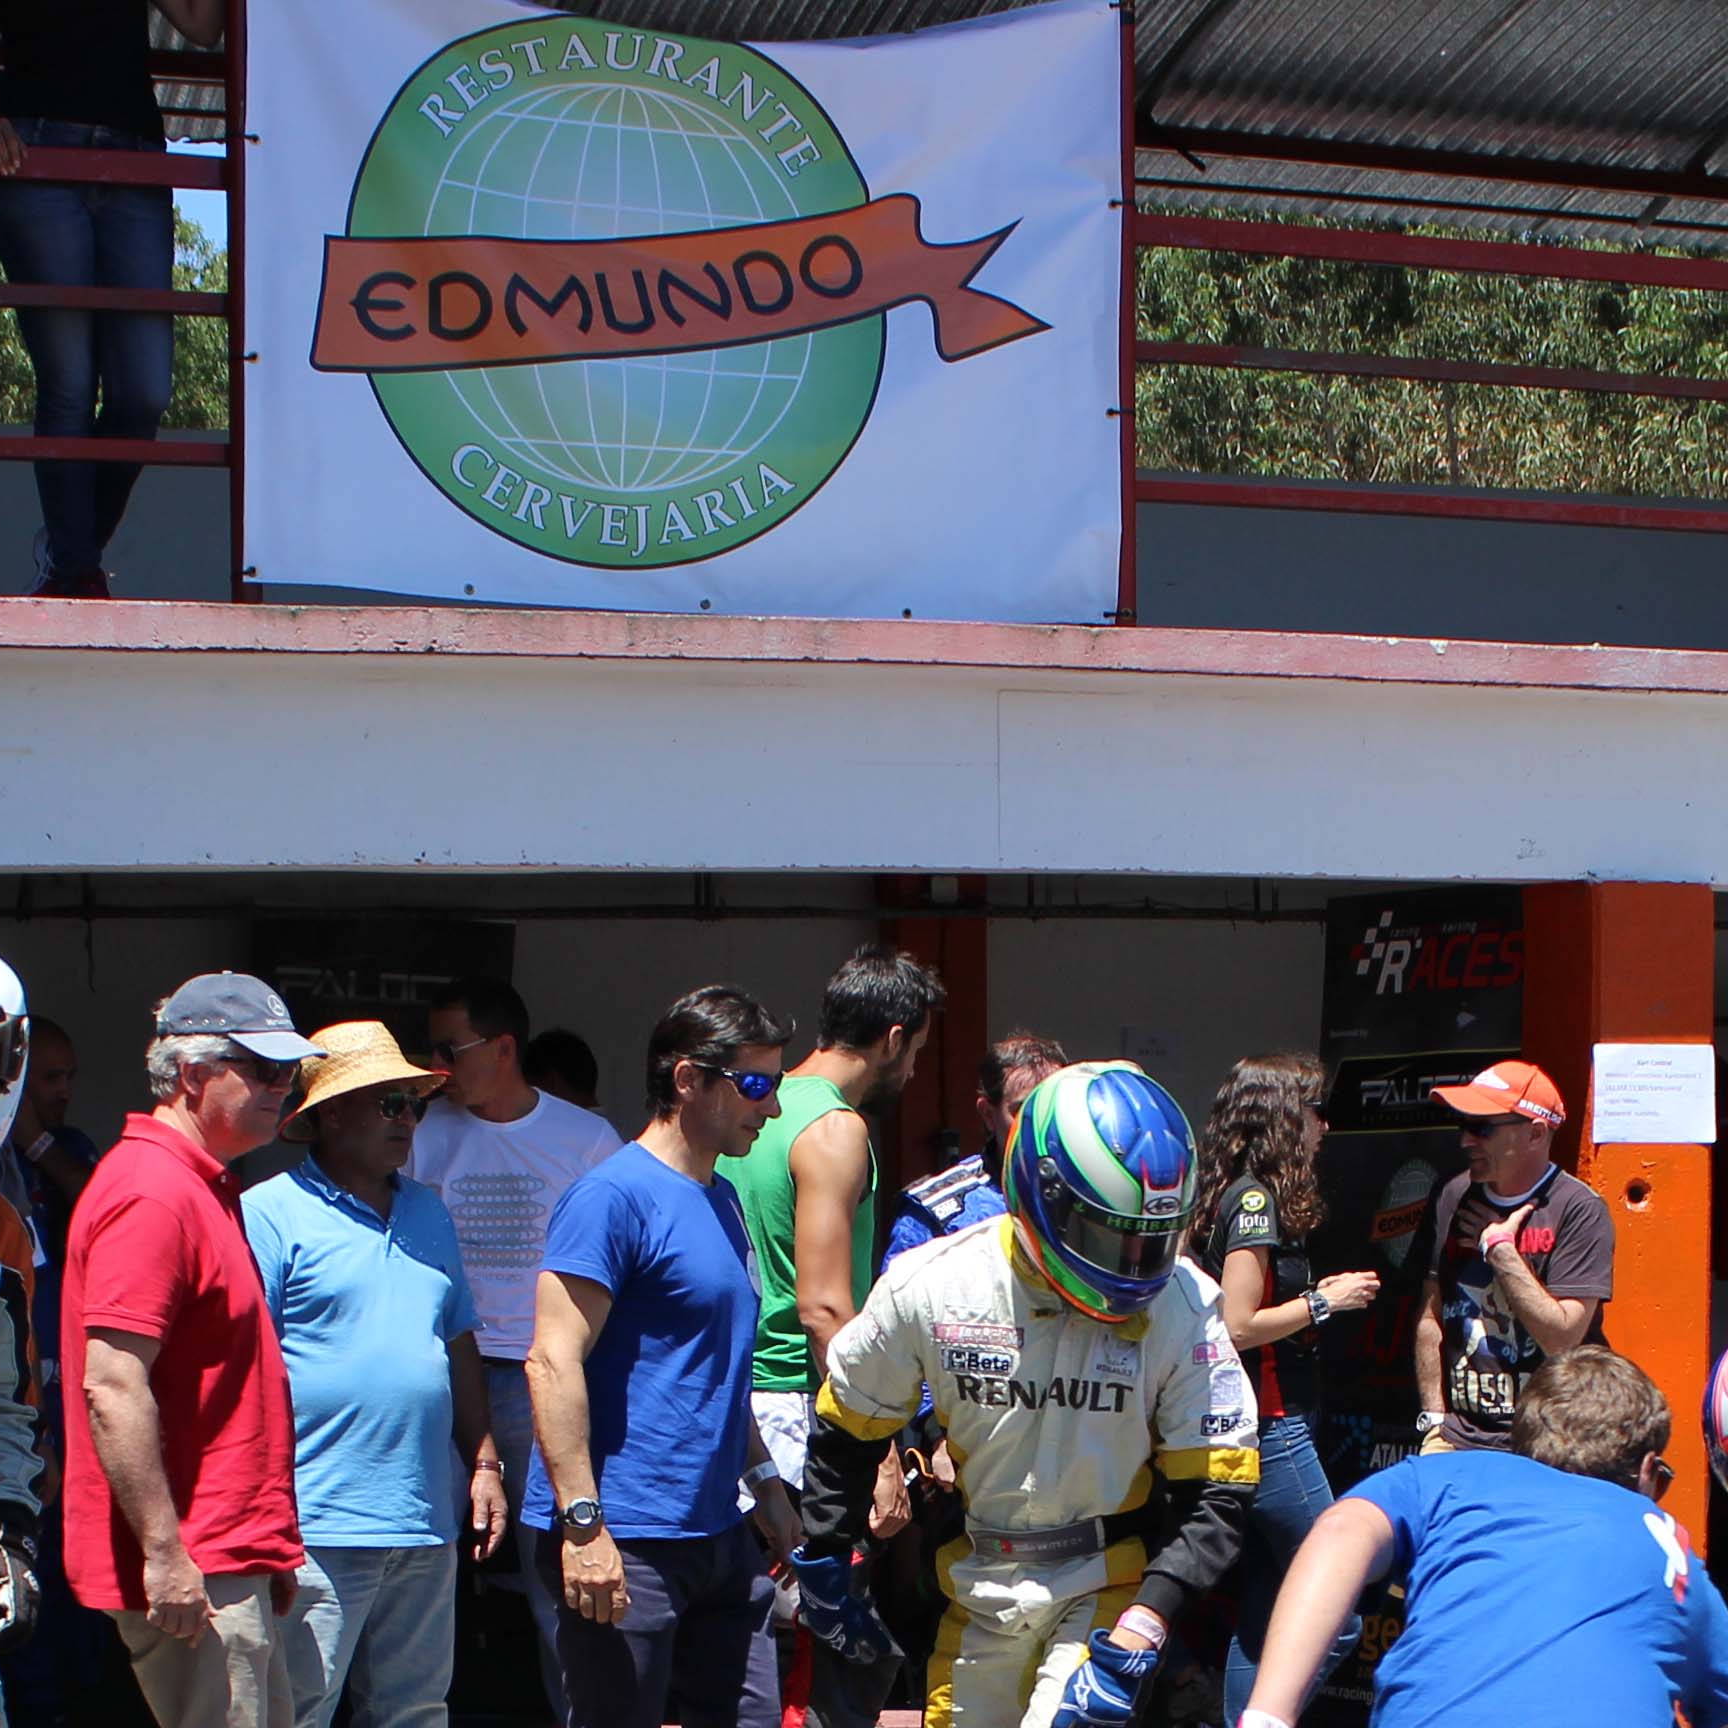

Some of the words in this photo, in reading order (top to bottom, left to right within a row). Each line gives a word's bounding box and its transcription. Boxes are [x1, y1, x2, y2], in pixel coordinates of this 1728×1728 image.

[418, 31, 822, 180] RESTAURANTE
[350, 233, 866, 341] EDMUNDO
[450, 443, 797, 558] CERVEJARIA
[955, 1374, 1134, 1413] RENAULT
[967, 1352, 1012, 1372] Beta
